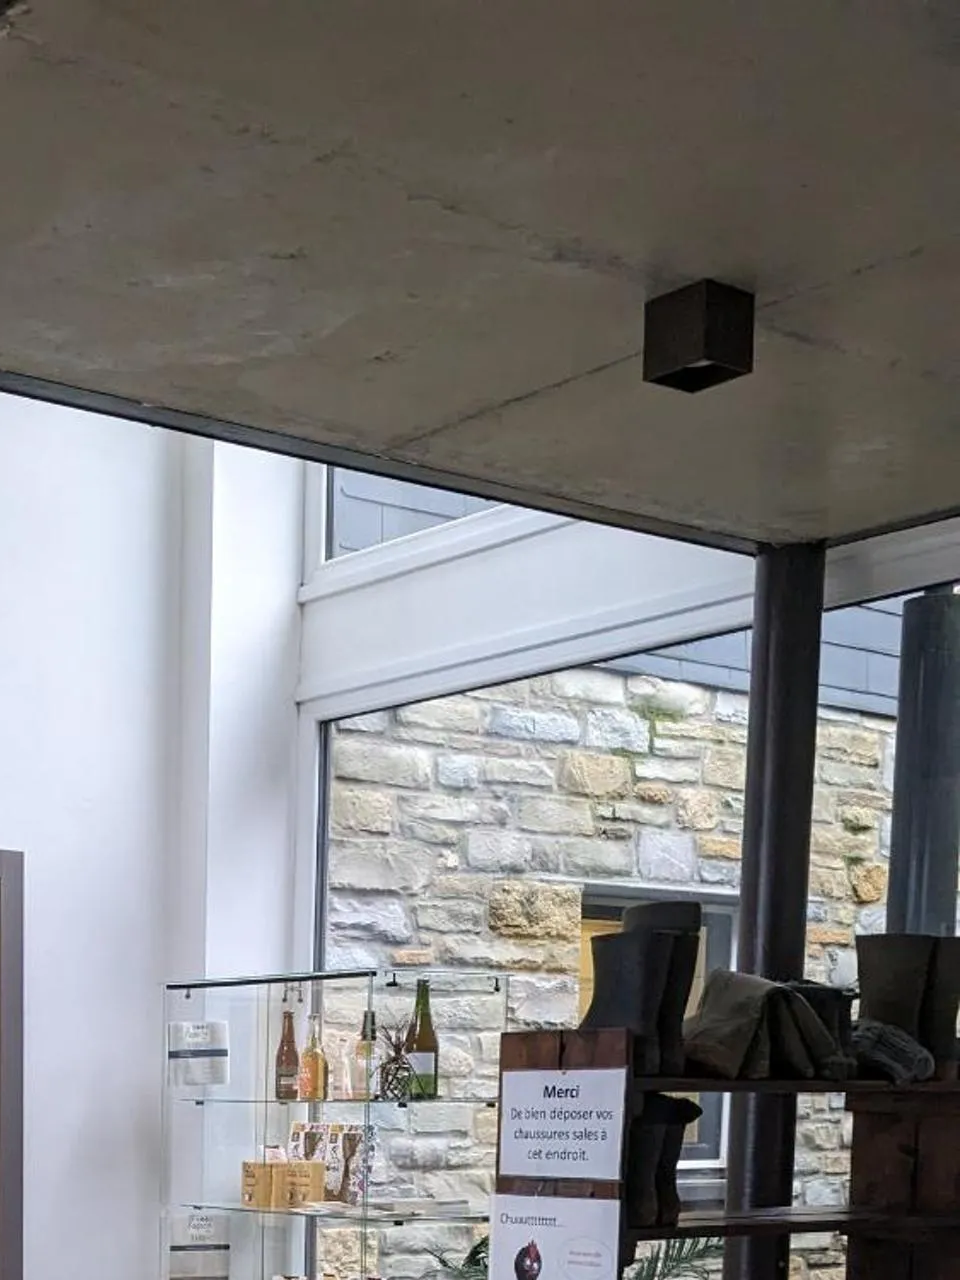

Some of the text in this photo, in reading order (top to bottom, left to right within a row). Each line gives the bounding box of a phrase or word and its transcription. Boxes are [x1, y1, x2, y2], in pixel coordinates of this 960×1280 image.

[543, 1084, 580, 1099] Merci
[510, 1107, 614, 1122] De bien déposer vos
[514, 1127, 608, 1141] chaussures sales à
[527, 1148, 589, 1161] cet endroit.
